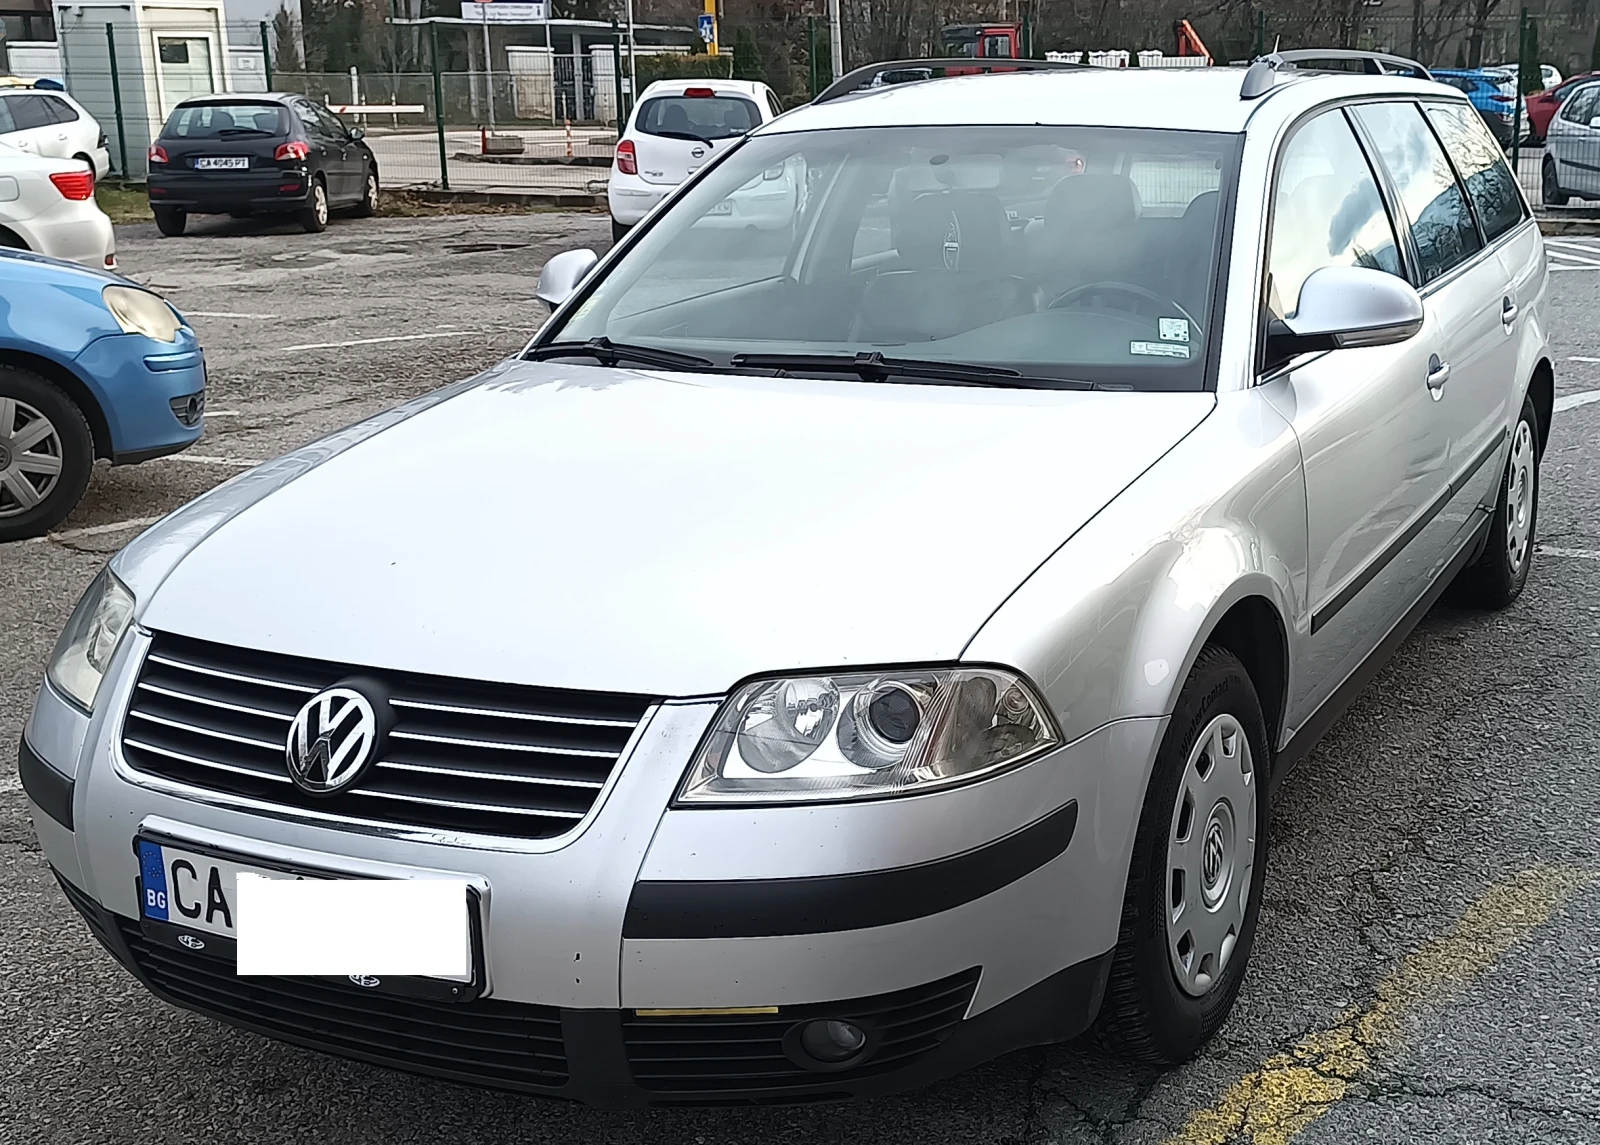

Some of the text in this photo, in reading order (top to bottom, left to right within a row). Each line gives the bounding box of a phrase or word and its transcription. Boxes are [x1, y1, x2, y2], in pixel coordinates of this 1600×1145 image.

[200, 159, 211, 168] CA
[1178, 677, 1229, 761] WinterContact
[146, 858, 234, 929] BG CA
